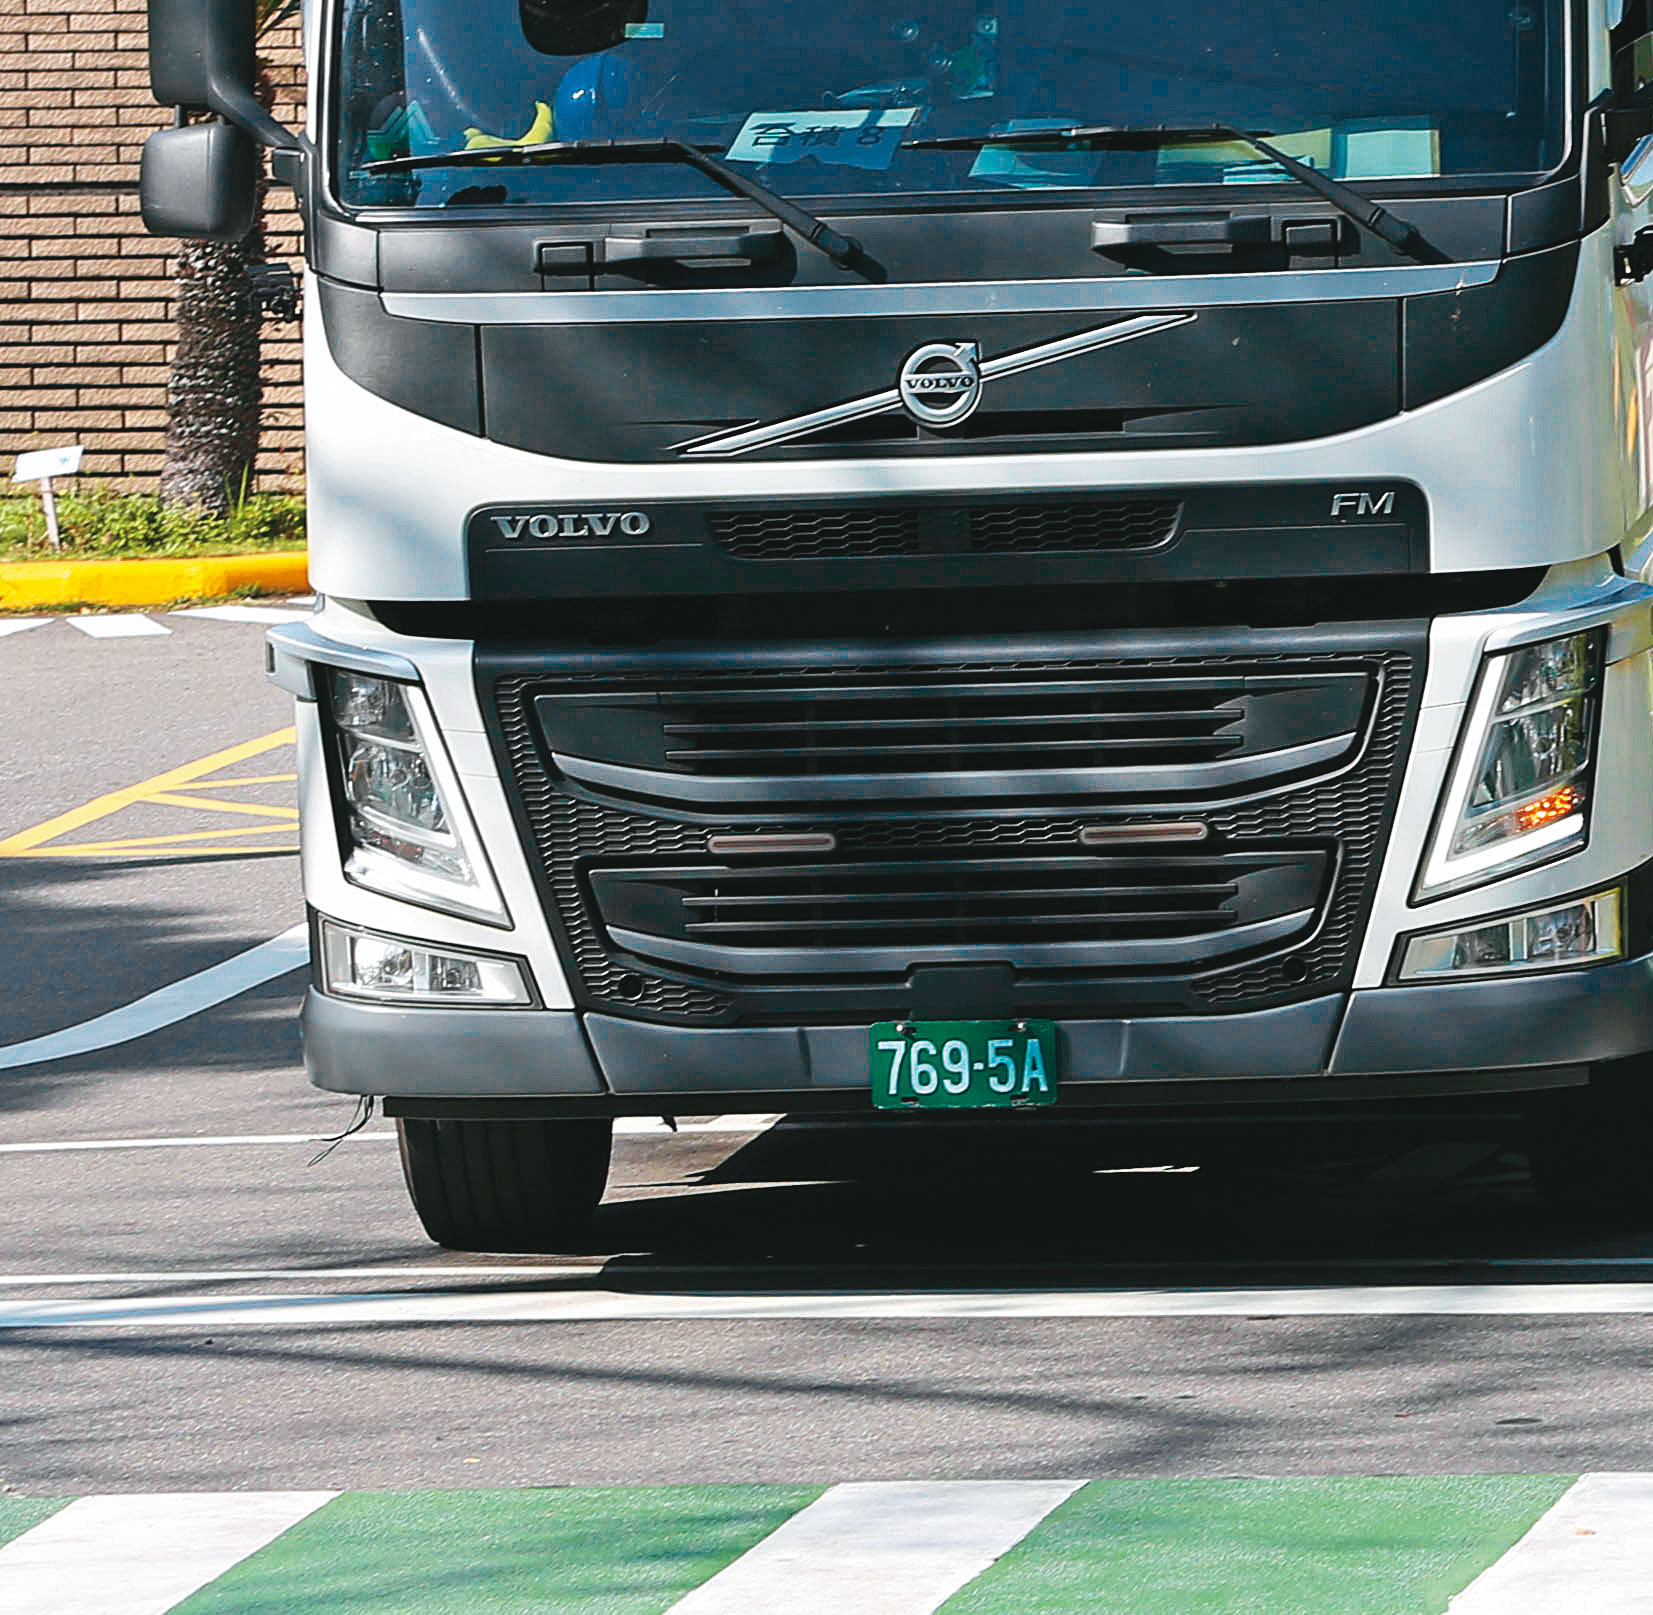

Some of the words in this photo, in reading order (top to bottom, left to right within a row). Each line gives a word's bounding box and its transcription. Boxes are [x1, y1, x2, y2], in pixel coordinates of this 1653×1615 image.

[904, 376, 975, 389] VOLVO
[1330, 491, 1396, 516] FM
[489, 511, 650, 539] VOLVO
[877, 1038, 1049, 1095] 769-5A
